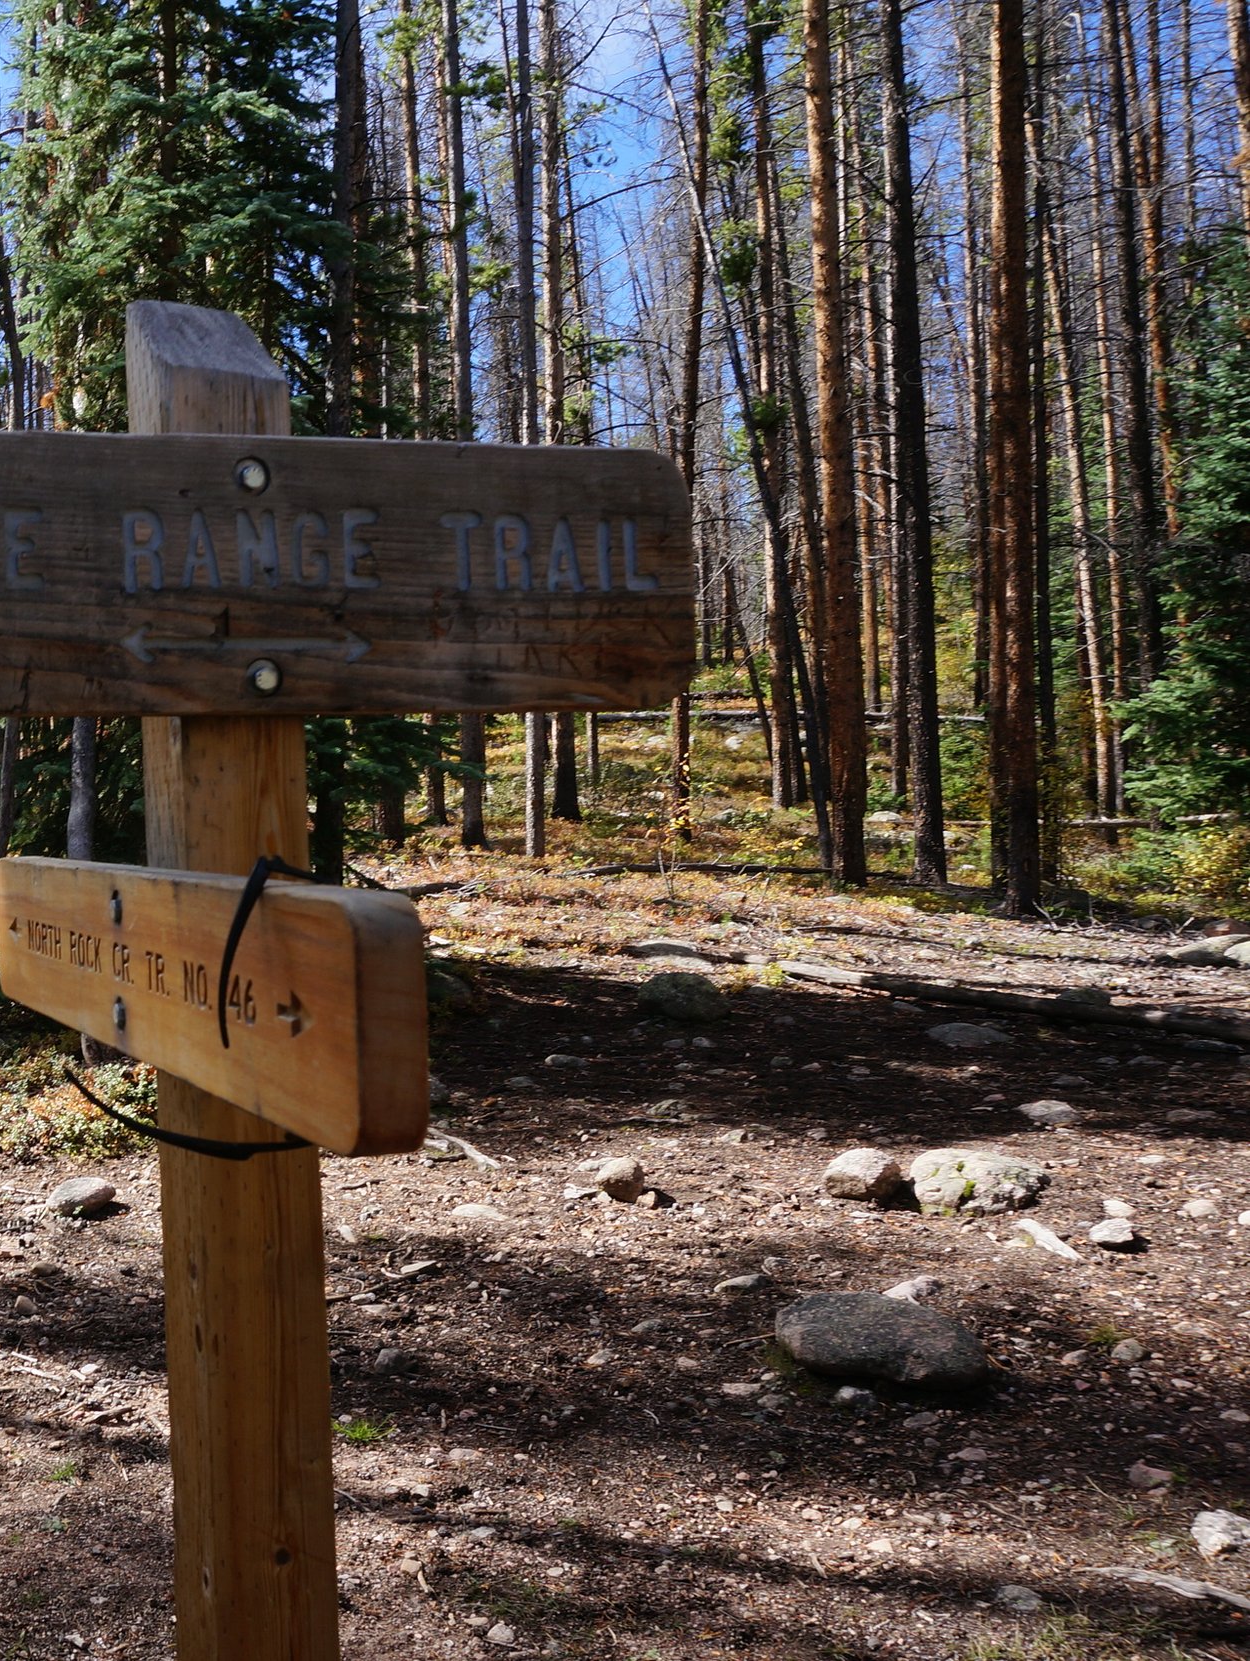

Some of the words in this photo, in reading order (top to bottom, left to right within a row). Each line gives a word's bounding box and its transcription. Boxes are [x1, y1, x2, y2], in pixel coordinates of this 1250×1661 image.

[120, 505, 381, 594] RANGE
[439, 510, 659, 592] TRAIL
[27, 919, 62, 960] NORTH
[69, 930, 102, 974] ROCK
[112, 941, 134, 985] CR.
[145, 950, 170, 997] TR.
[183, 960, 212, 1011] NO.
[228, 973, 256, 1025] 46
